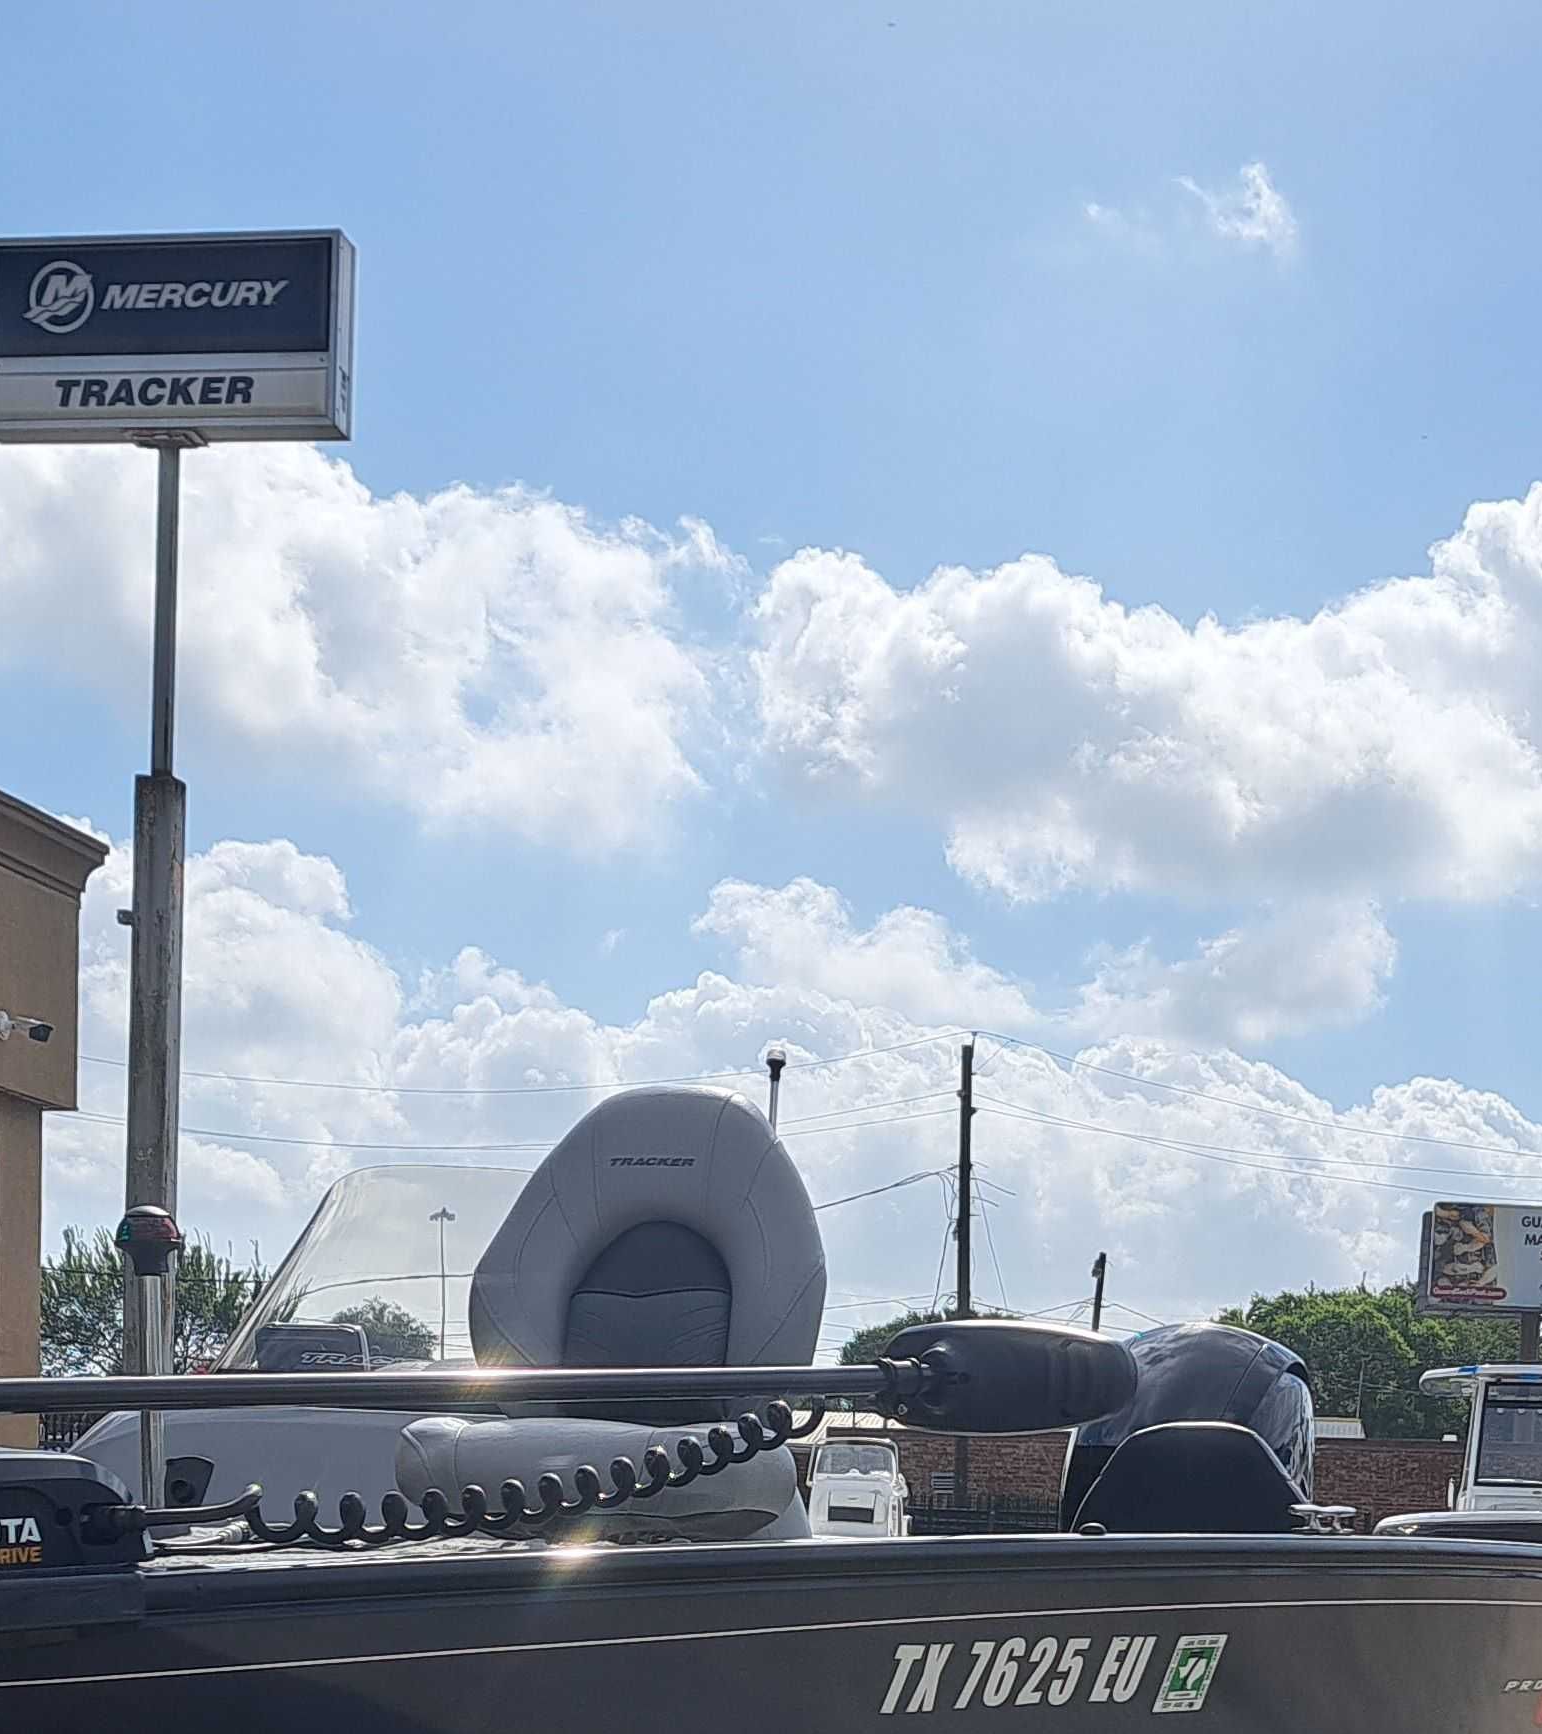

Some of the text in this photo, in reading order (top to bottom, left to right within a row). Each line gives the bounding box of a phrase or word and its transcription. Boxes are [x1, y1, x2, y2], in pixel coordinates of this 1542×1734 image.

[100, 279, 290, 311] MERCURY
[55, 375, 255, 407] TRACKER
[609, 1155, 696, 1168] TRACKER
[878, 1635, 1158, 1715] TX 7625 EU
